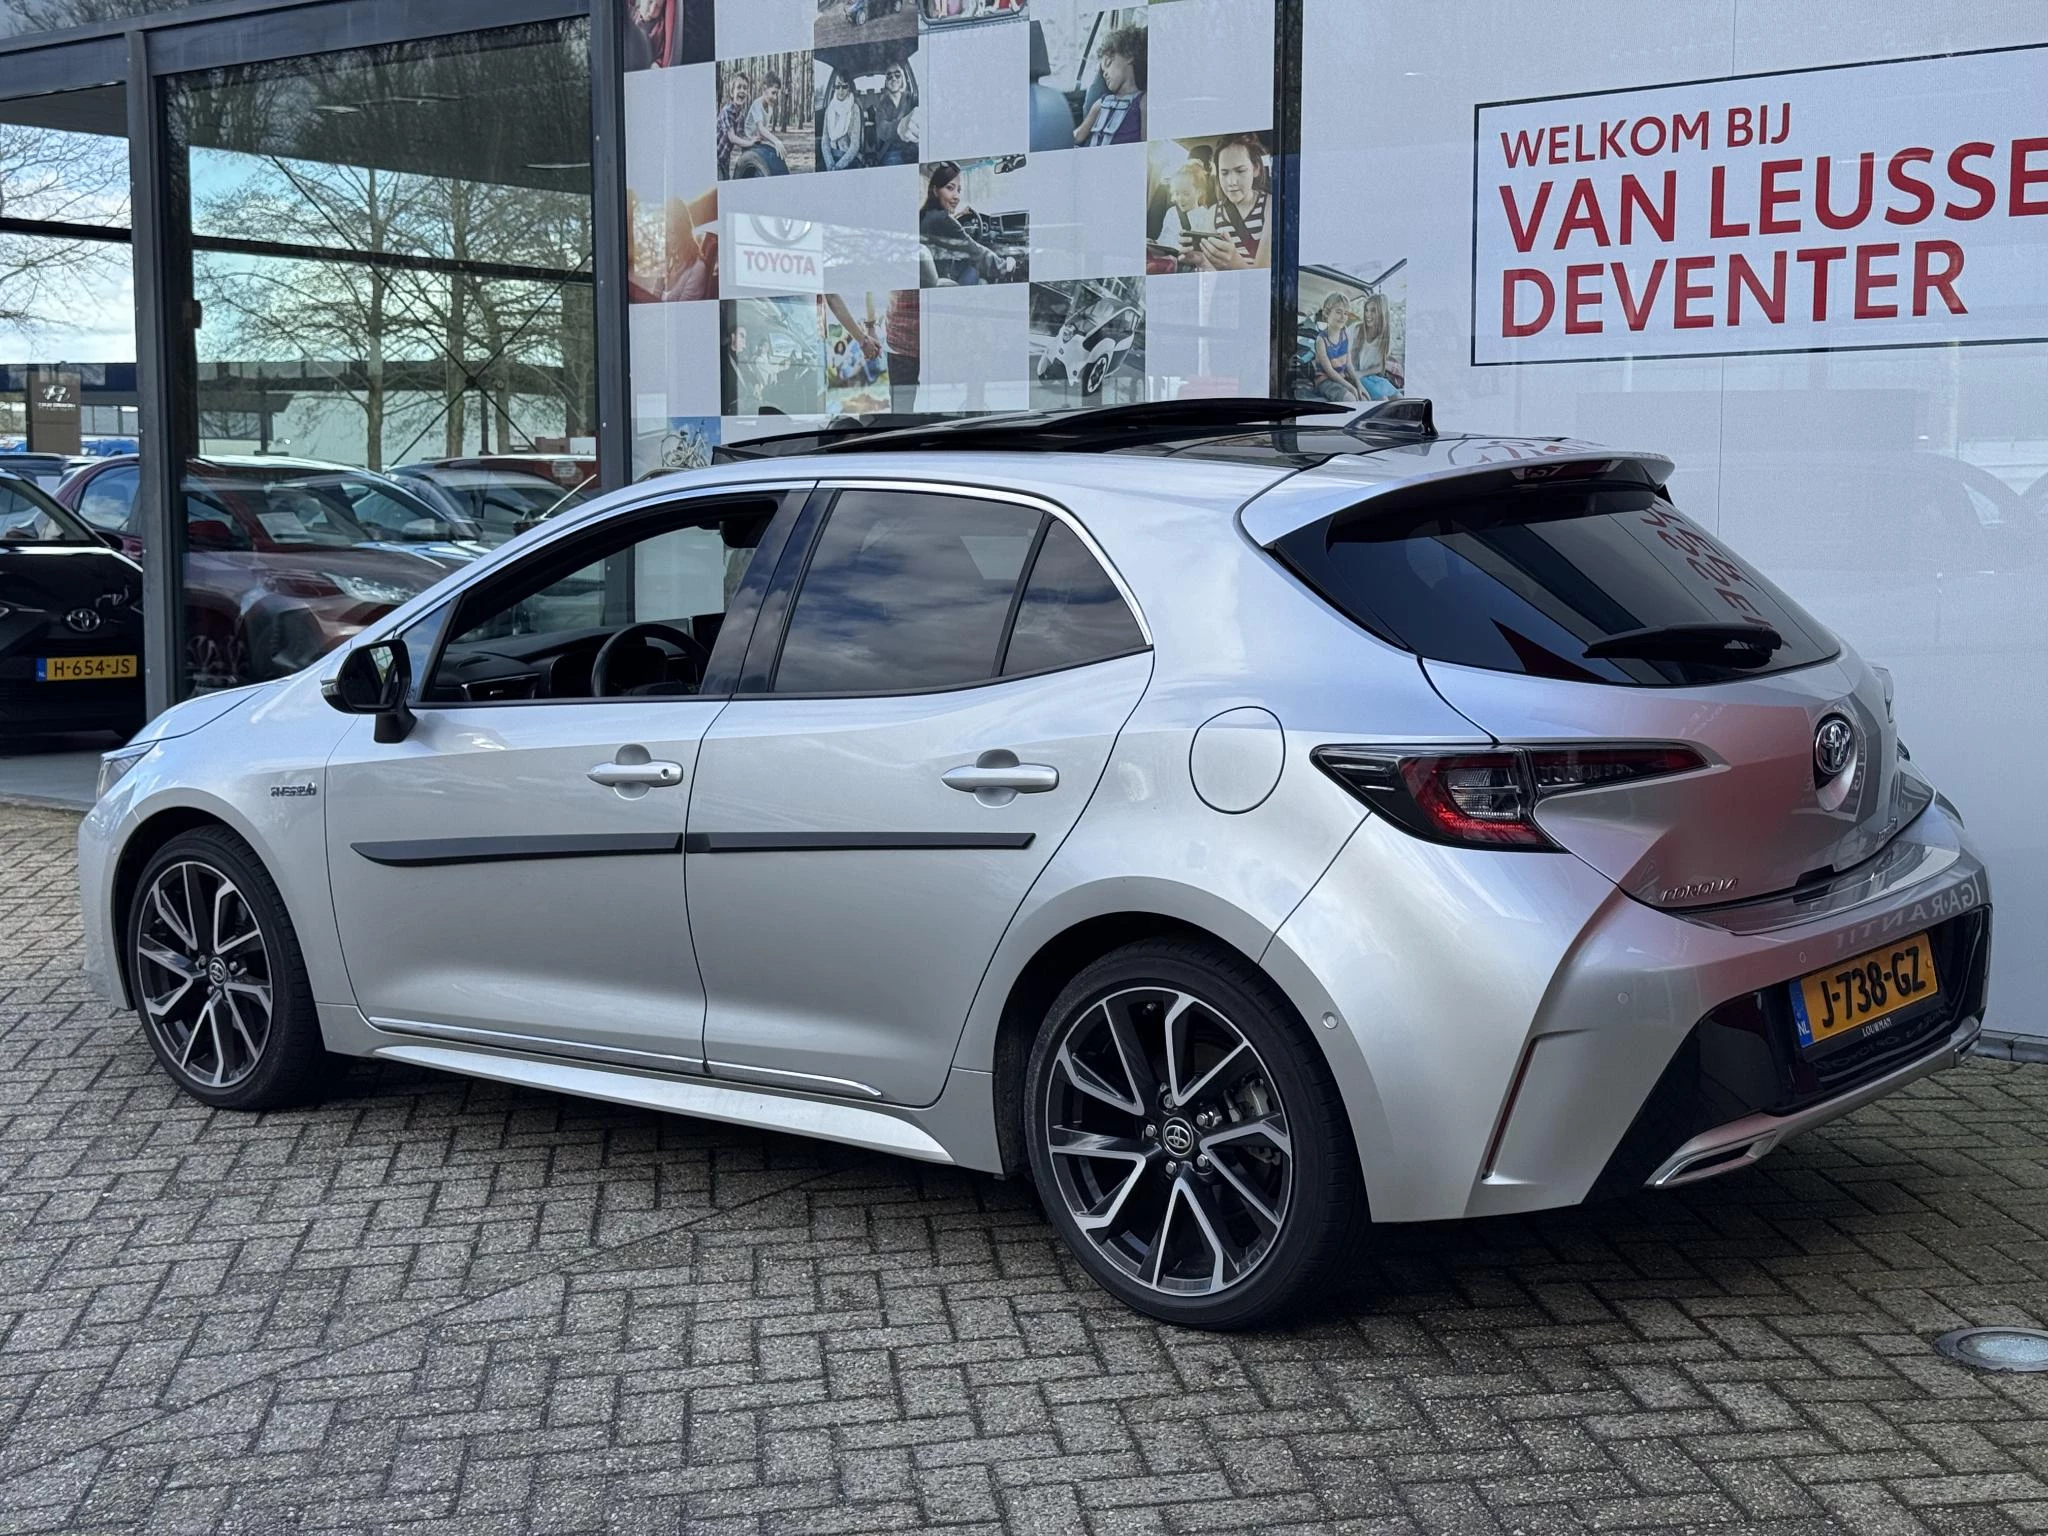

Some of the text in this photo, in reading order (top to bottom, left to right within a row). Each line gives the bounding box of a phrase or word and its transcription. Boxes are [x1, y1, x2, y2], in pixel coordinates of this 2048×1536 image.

[1500, 102, 1791, 169] WELKOM BIJ
[1499, 136, 2048, 253] VAN LEUSSE
[743, 249, 816, 276] TOYOTA
[1502, 239, 1969, 338] DEVENTER
[54, 659, 130, 678] H-654-JS
[1819, 945, 1928, 1029] J-738-GZ
[1797, 1022, 1811, 1038] NL
